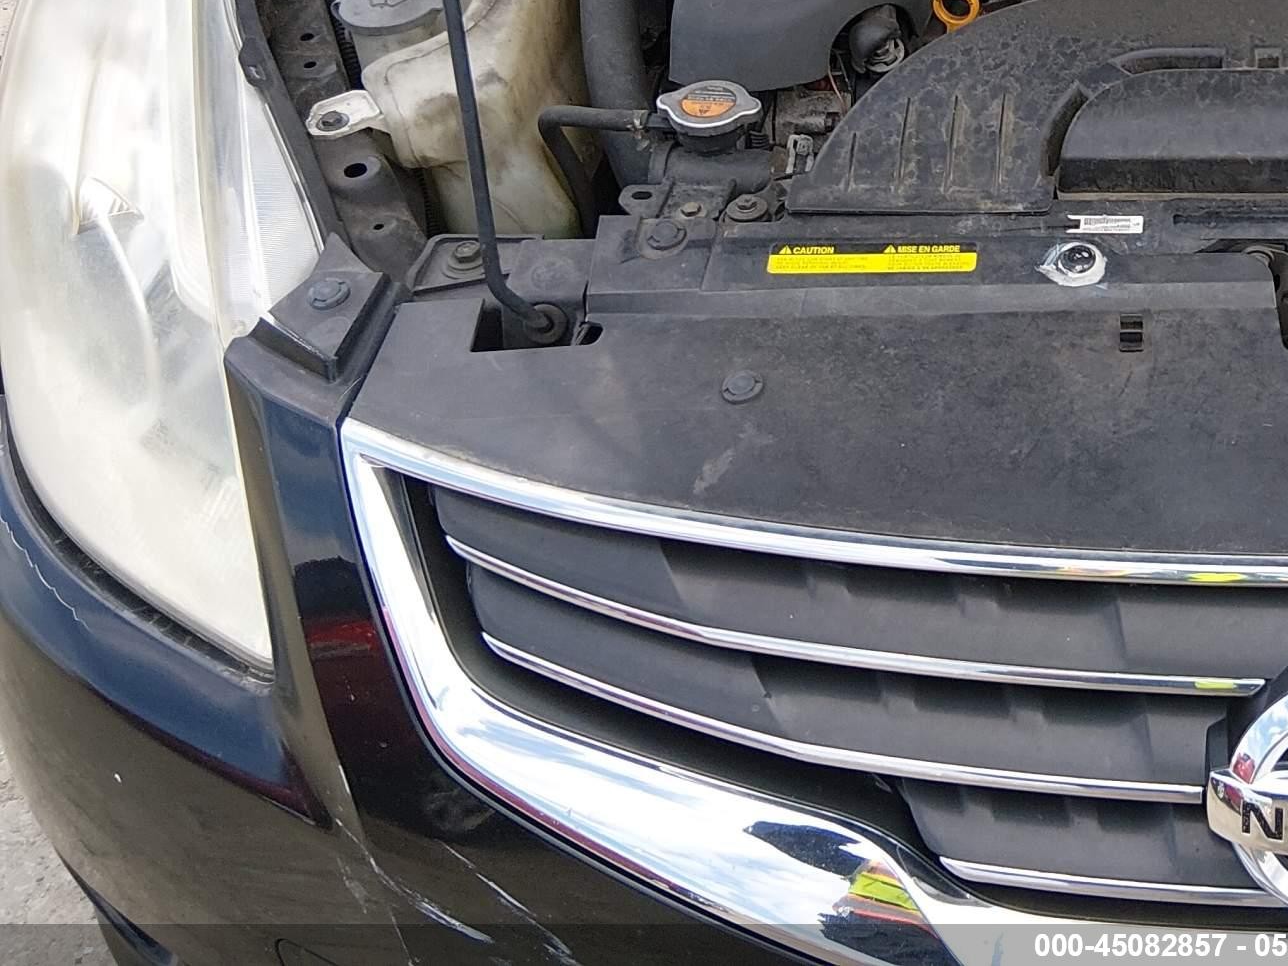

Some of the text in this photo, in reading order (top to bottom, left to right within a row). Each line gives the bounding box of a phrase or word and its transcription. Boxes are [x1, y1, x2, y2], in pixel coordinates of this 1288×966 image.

[793, 246, 835, 254] CAUTION
[897, 245, 961, 253] MISE EN GARDE
